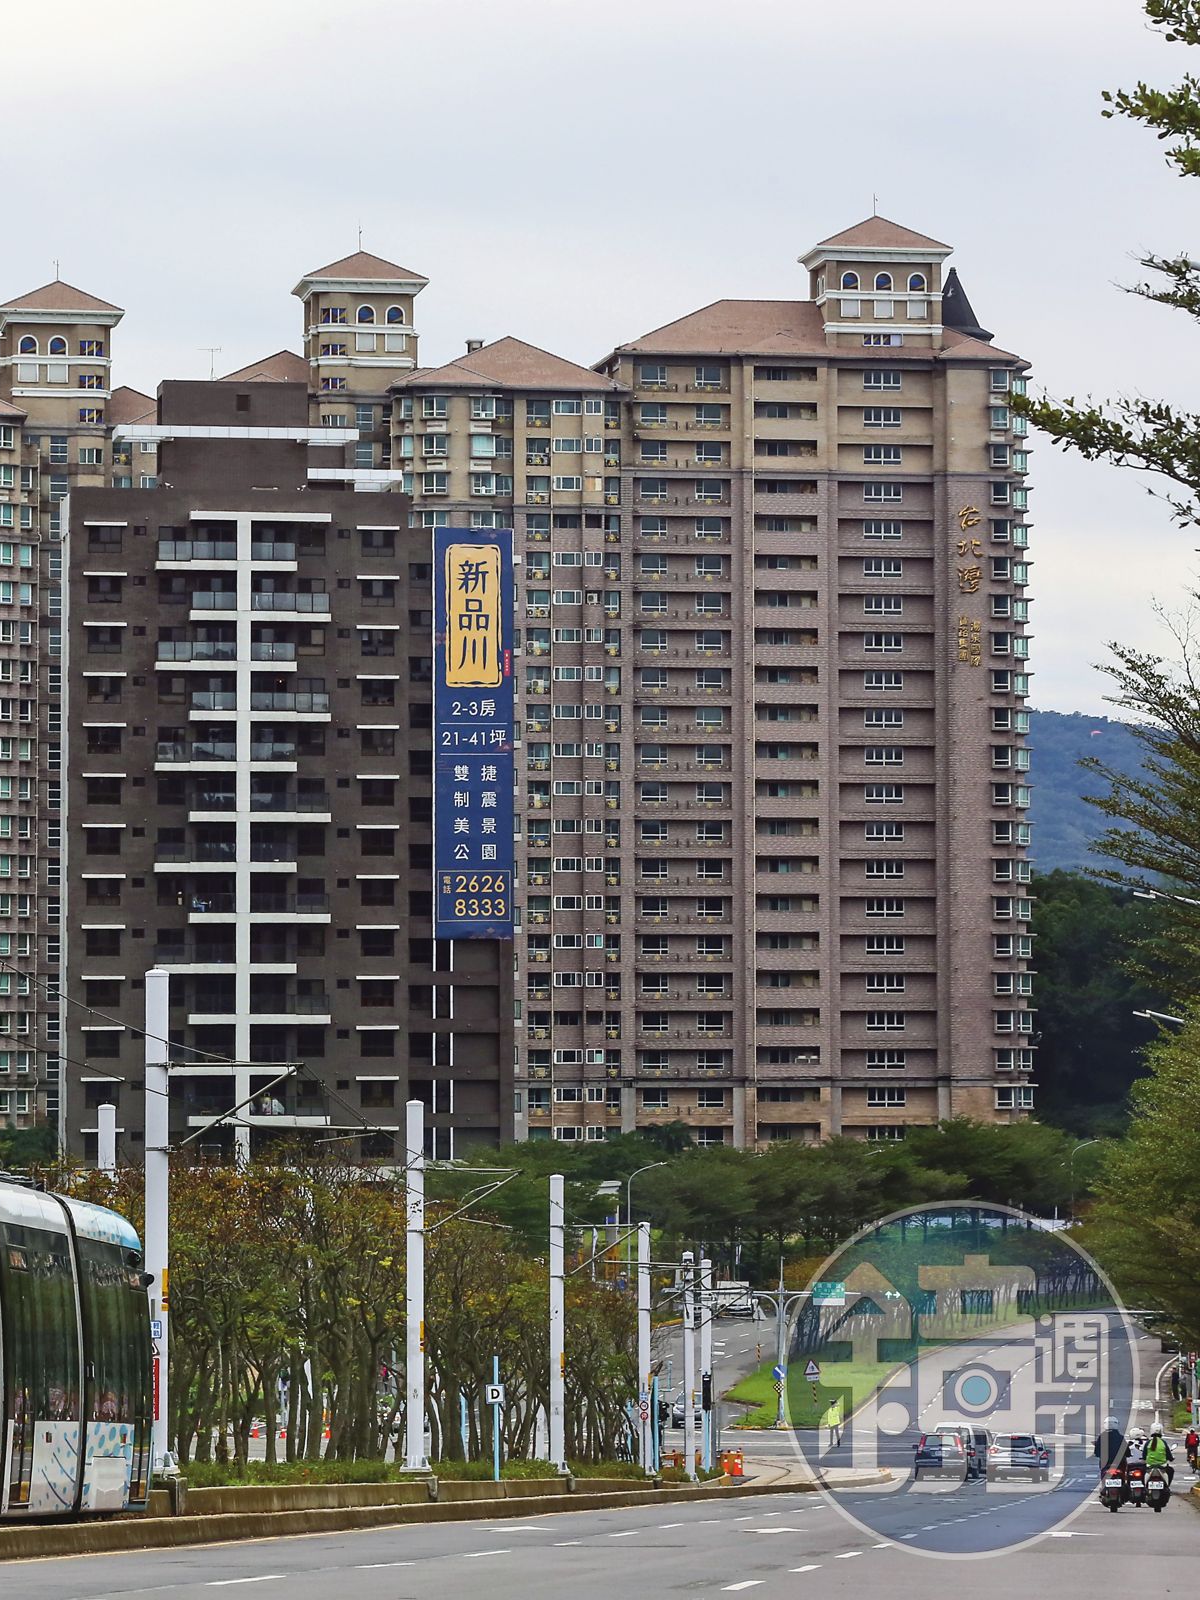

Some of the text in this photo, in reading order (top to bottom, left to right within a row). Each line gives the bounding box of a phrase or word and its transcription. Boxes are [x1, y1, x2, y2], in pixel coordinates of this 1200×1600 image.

[957, 504, 984, 594] 台北灣
[457, 560, 490, 670] 新品川
[451, 700, 497, 718] 2-3房
[441, 729, 507, 747] 21-41坪
[455, 875, 506, 893] 2626
[455, 898, 506, 917] 8333
[491, 1388, 500, 1400] D
